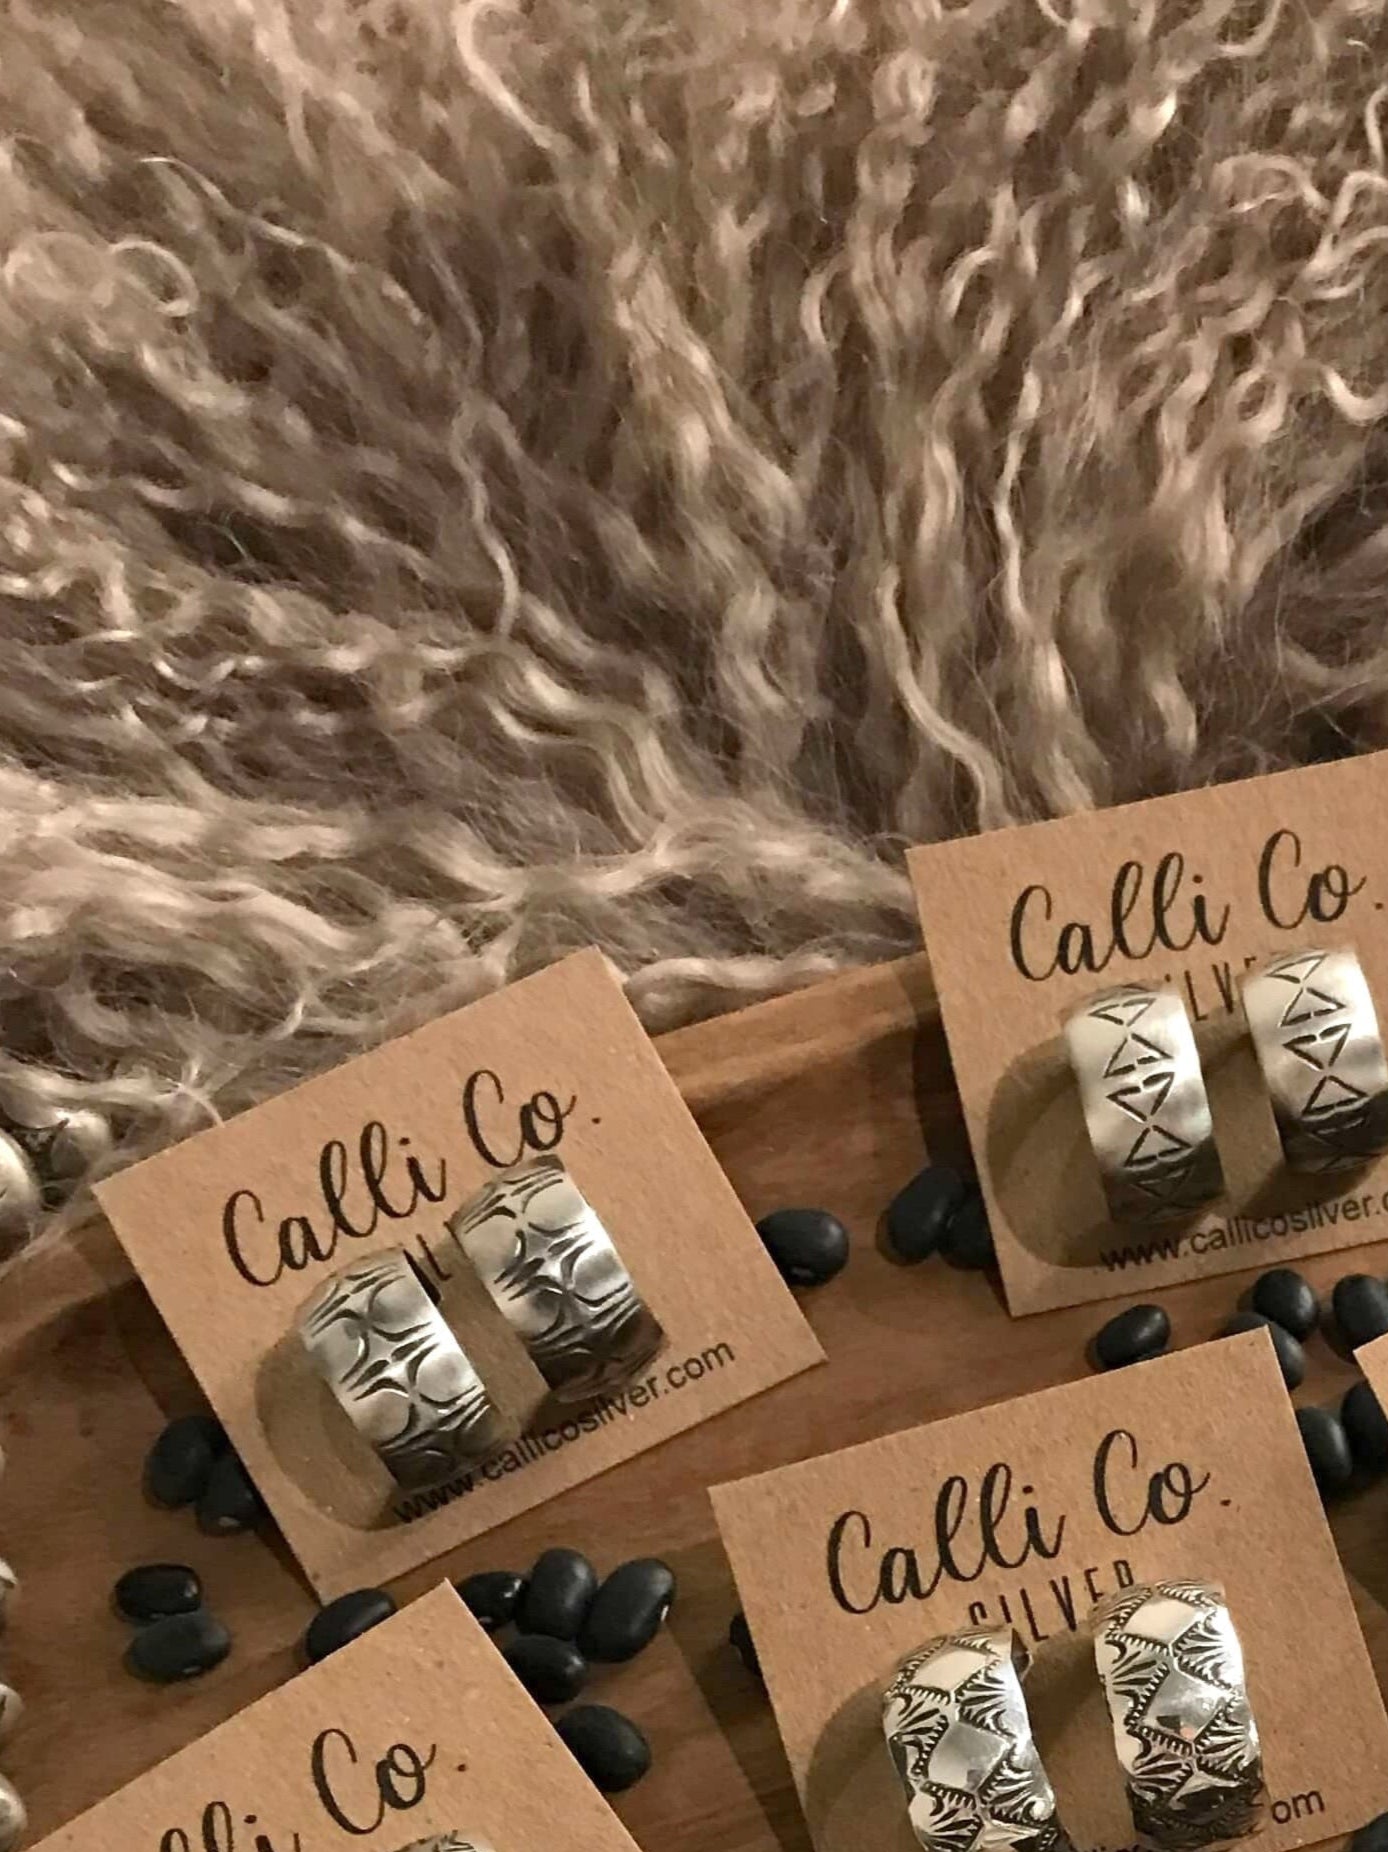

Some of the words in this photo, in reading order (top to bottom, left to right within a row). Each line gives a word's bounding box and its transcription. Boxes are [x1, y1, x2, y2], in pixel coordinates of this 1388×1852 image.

[1010, 852, 1231, 982] Calli
[1258, 828, 1385, 931] Co.
[222, 1120, 447, 1287] Calli
[462, 1069, 602, 1168] Co.
[394, 1341, 736, 1525] www.callicosilver.com
[826, 1462, 1065, 1614] Calli
[1092, 1428, 1232, 1536] Co.
[311, 1728, 468, 1835] Co.
